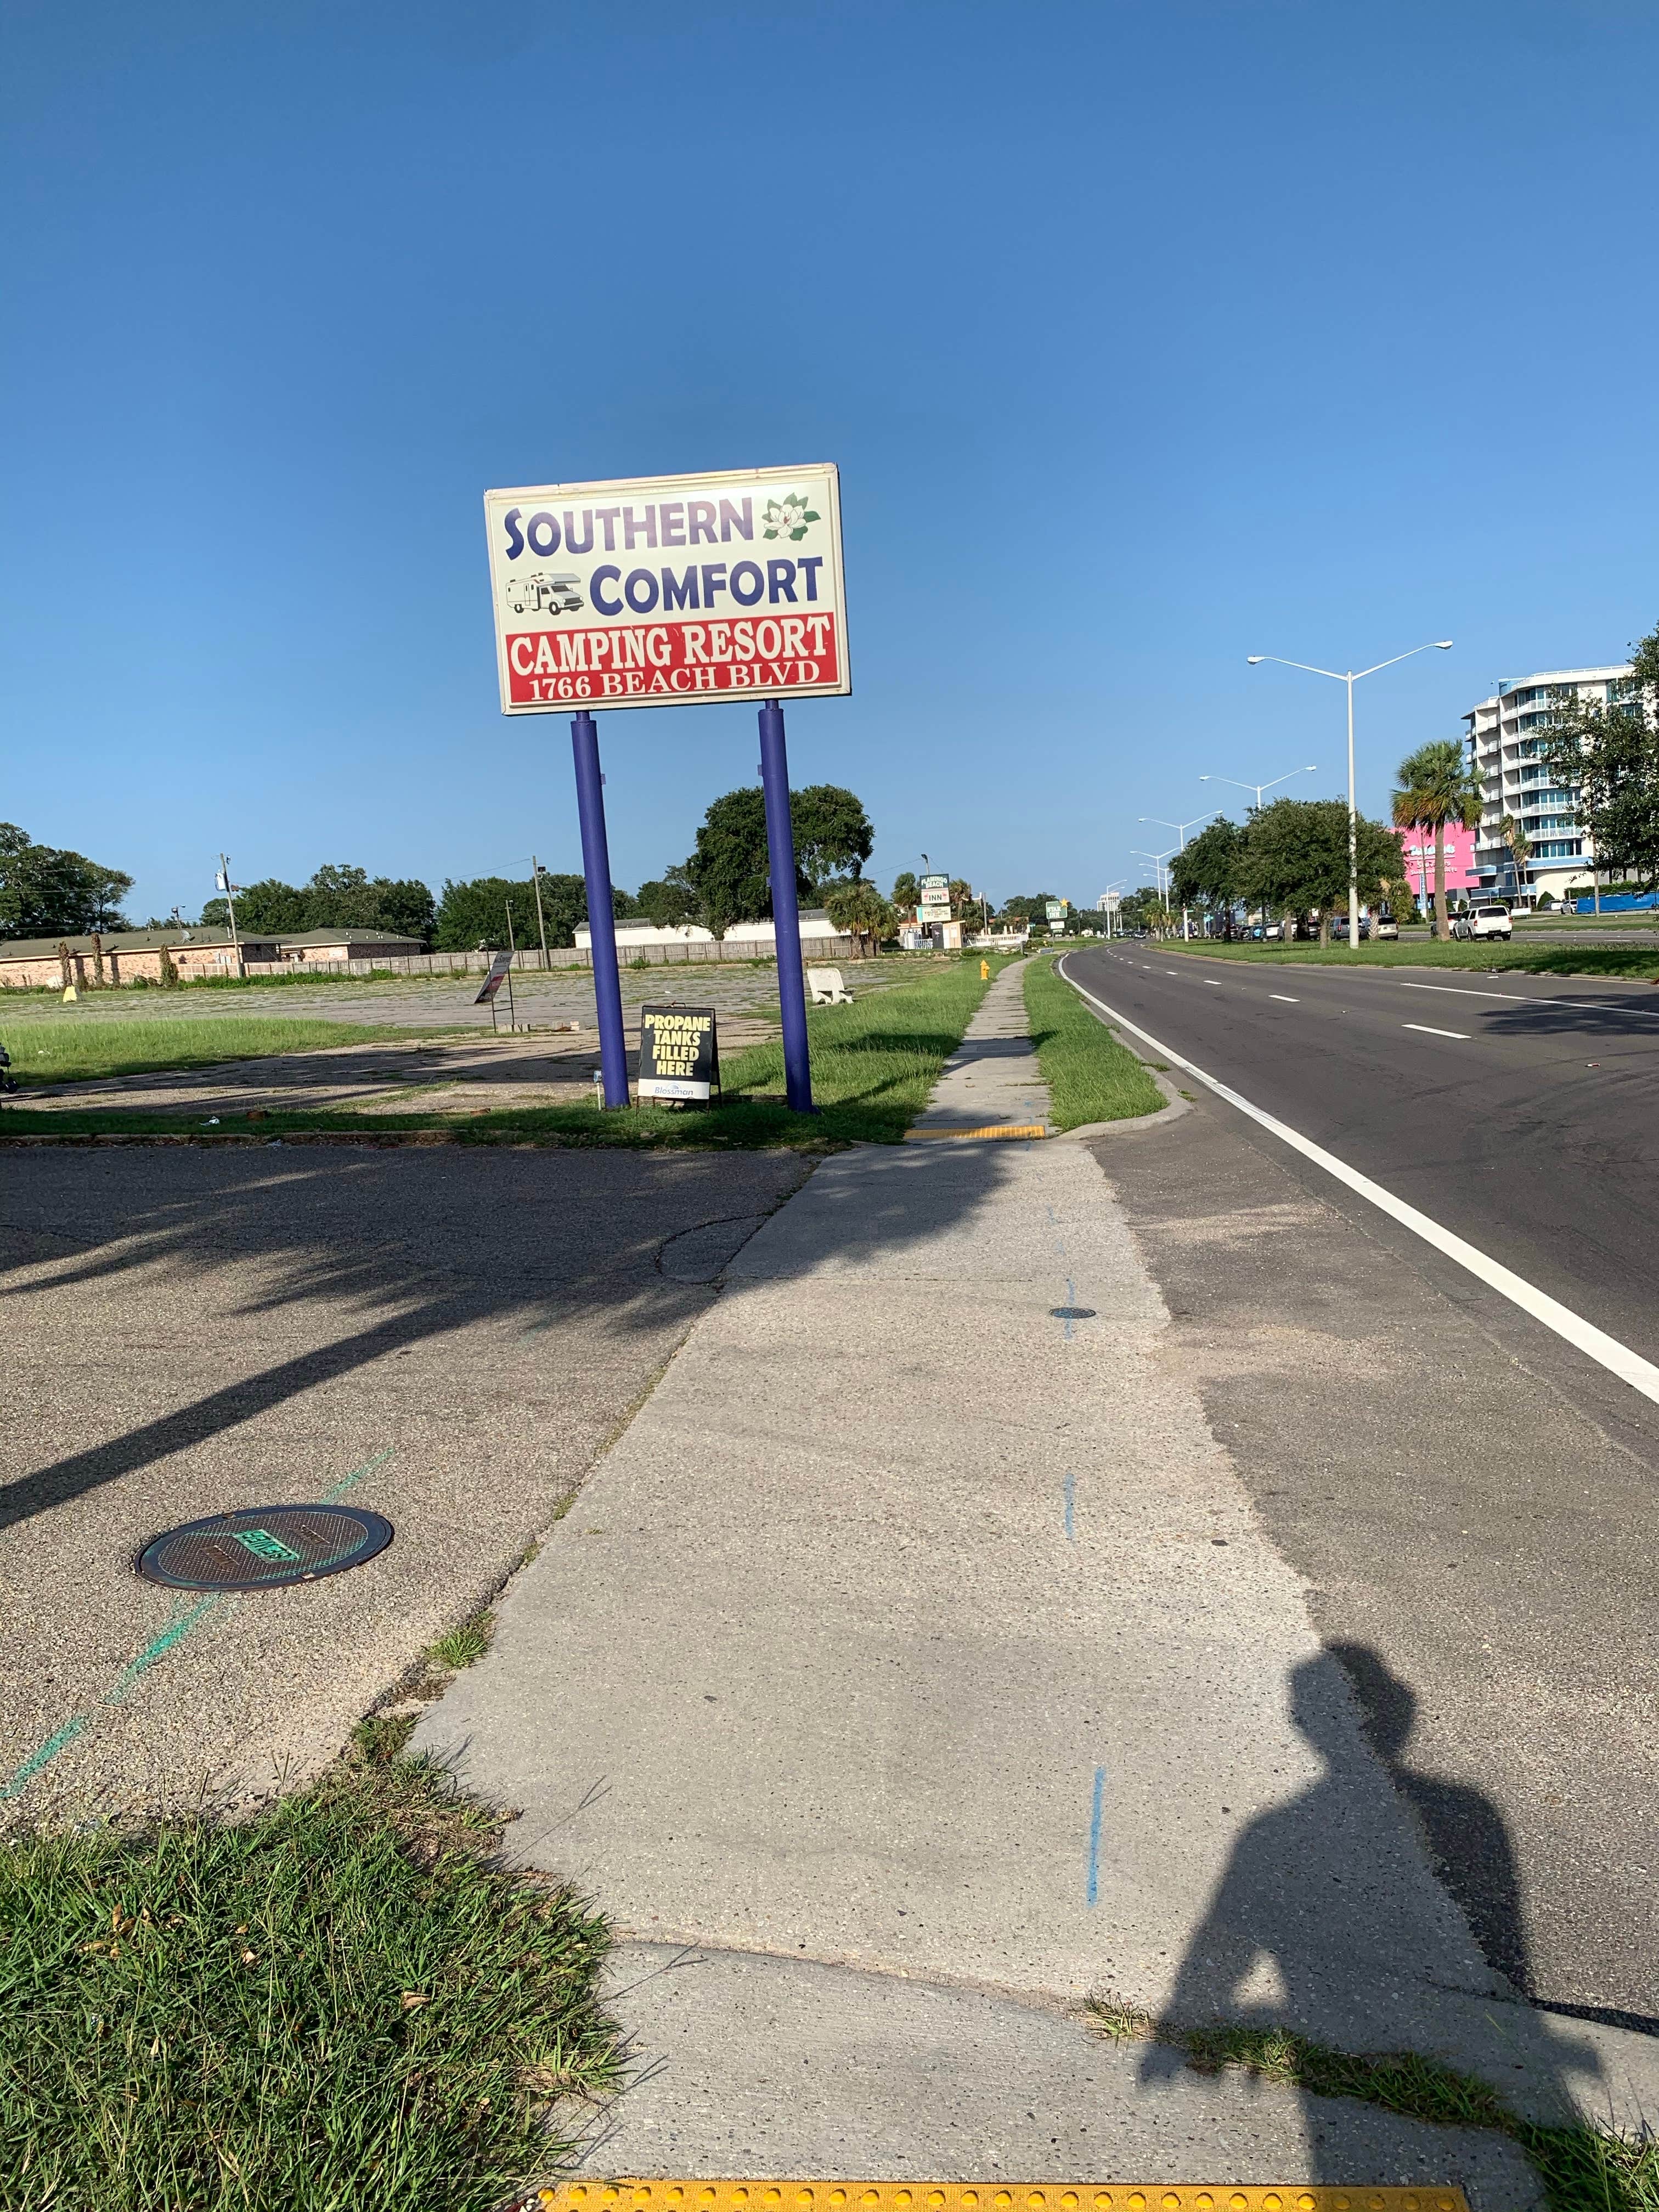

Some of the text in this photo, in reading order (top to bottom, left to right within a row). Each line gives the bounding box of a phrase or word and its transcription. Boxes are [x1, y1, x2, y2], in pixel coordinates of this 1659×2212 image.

[504, 497, 754, 561] SOUTHERN
[590, 556, 823, 616] COMFORT
[511, 616, 831, 676] CAMPING RESORT
[529, 660, 820, 701] 1766 BEACH BLVD
[921, 876, 947, 885] FLAMINGO
[645, 1014, 711, 1031] PROPANE
[653, 1030, 701, 1046] TANKS
[652, 1045, 699, 1061] FILLED
[656, 1060, 695, 1076] HERE
[655, 1086, 693, 1096] Blossman
[242, 1531, 292, 1559] SEWER
